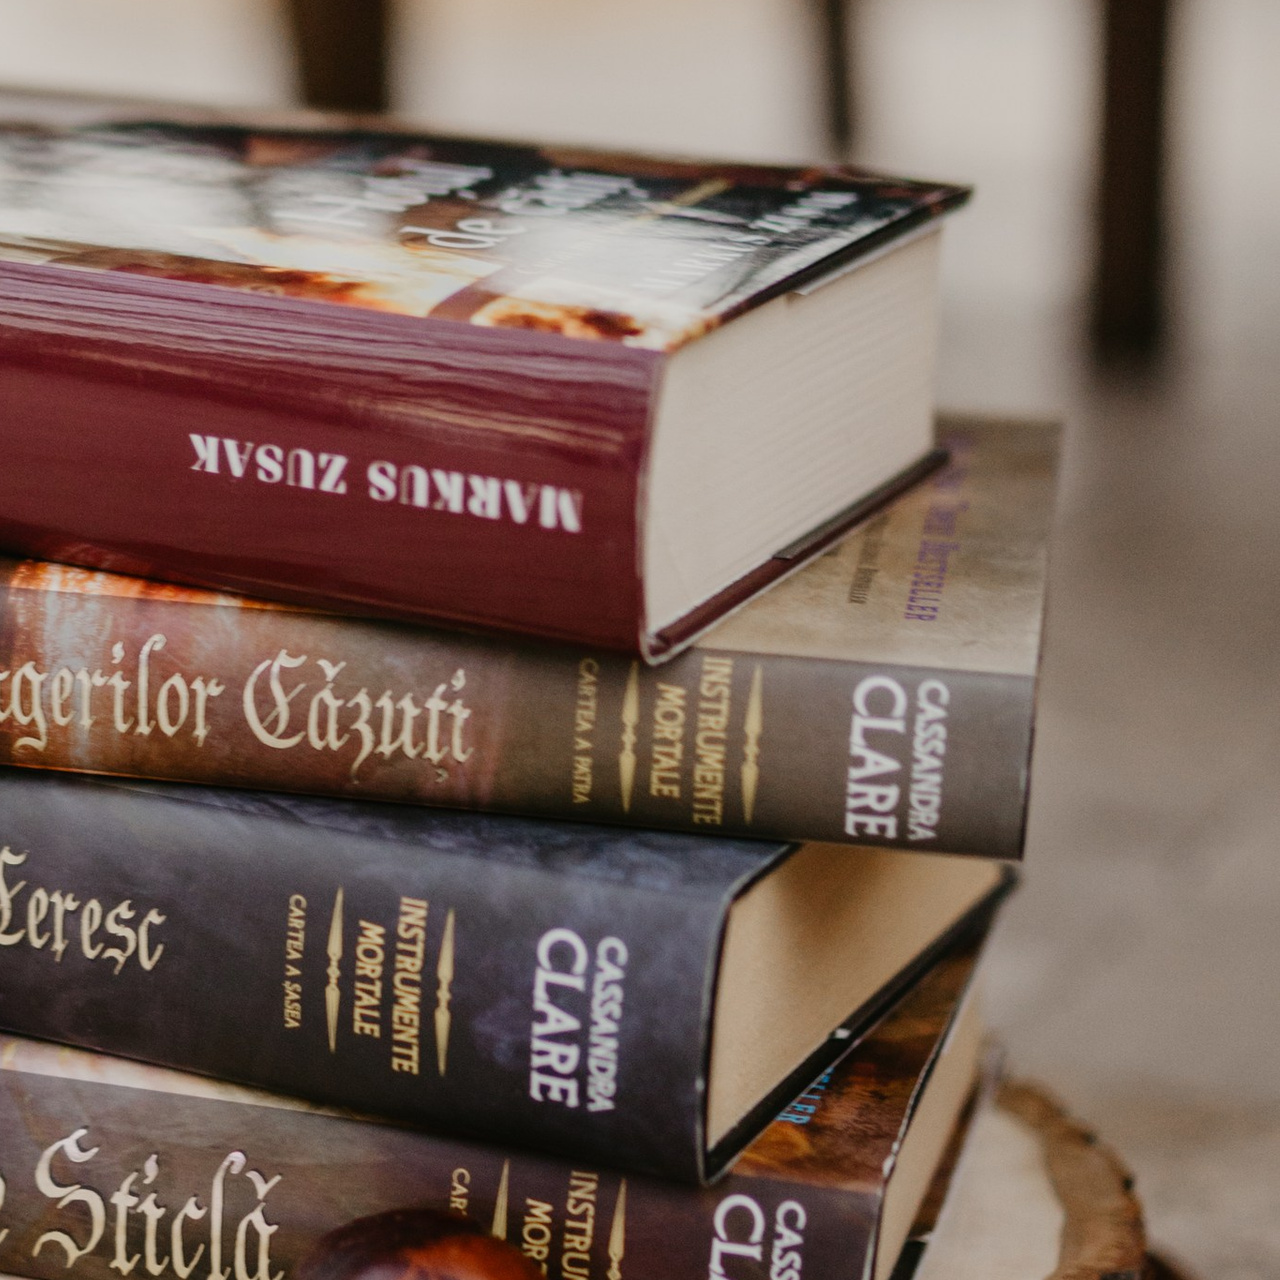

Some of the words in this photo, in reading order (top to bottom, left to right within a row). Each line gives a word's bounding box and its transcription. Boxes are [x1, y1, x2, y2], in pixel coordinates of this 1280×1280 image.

[400, 216, 526, 250] de
[188, 432, 349, 495] ZUSAK
[367, 460, 585, 534] MARKUS
[574, 657, 600, 732] CARTEA
[572, 754, 594, 804] PATRA
[573, 736, 594, 751] A
[649, 681, 687, 800] MORTALE
[693, 655, 734, 827] INSTRUMENTE
[845, 674, 908, 840] CLARE
[908, 678, 951, 842] CASSANDRA
[285, 894, 308, 963] CARTEA
[285, 964, 302, 978] A
[353, 919, 386, 1038] MORTALE
[391, 895, 429, 1076] INSTRUMENTE
[529, 927, 590, 1109] CLARE
[586, 935, 629, 1113] CASSANDRA
[449, 1167, 472, 1216] CAR
[521, 1197, 555, 1277] MOR
